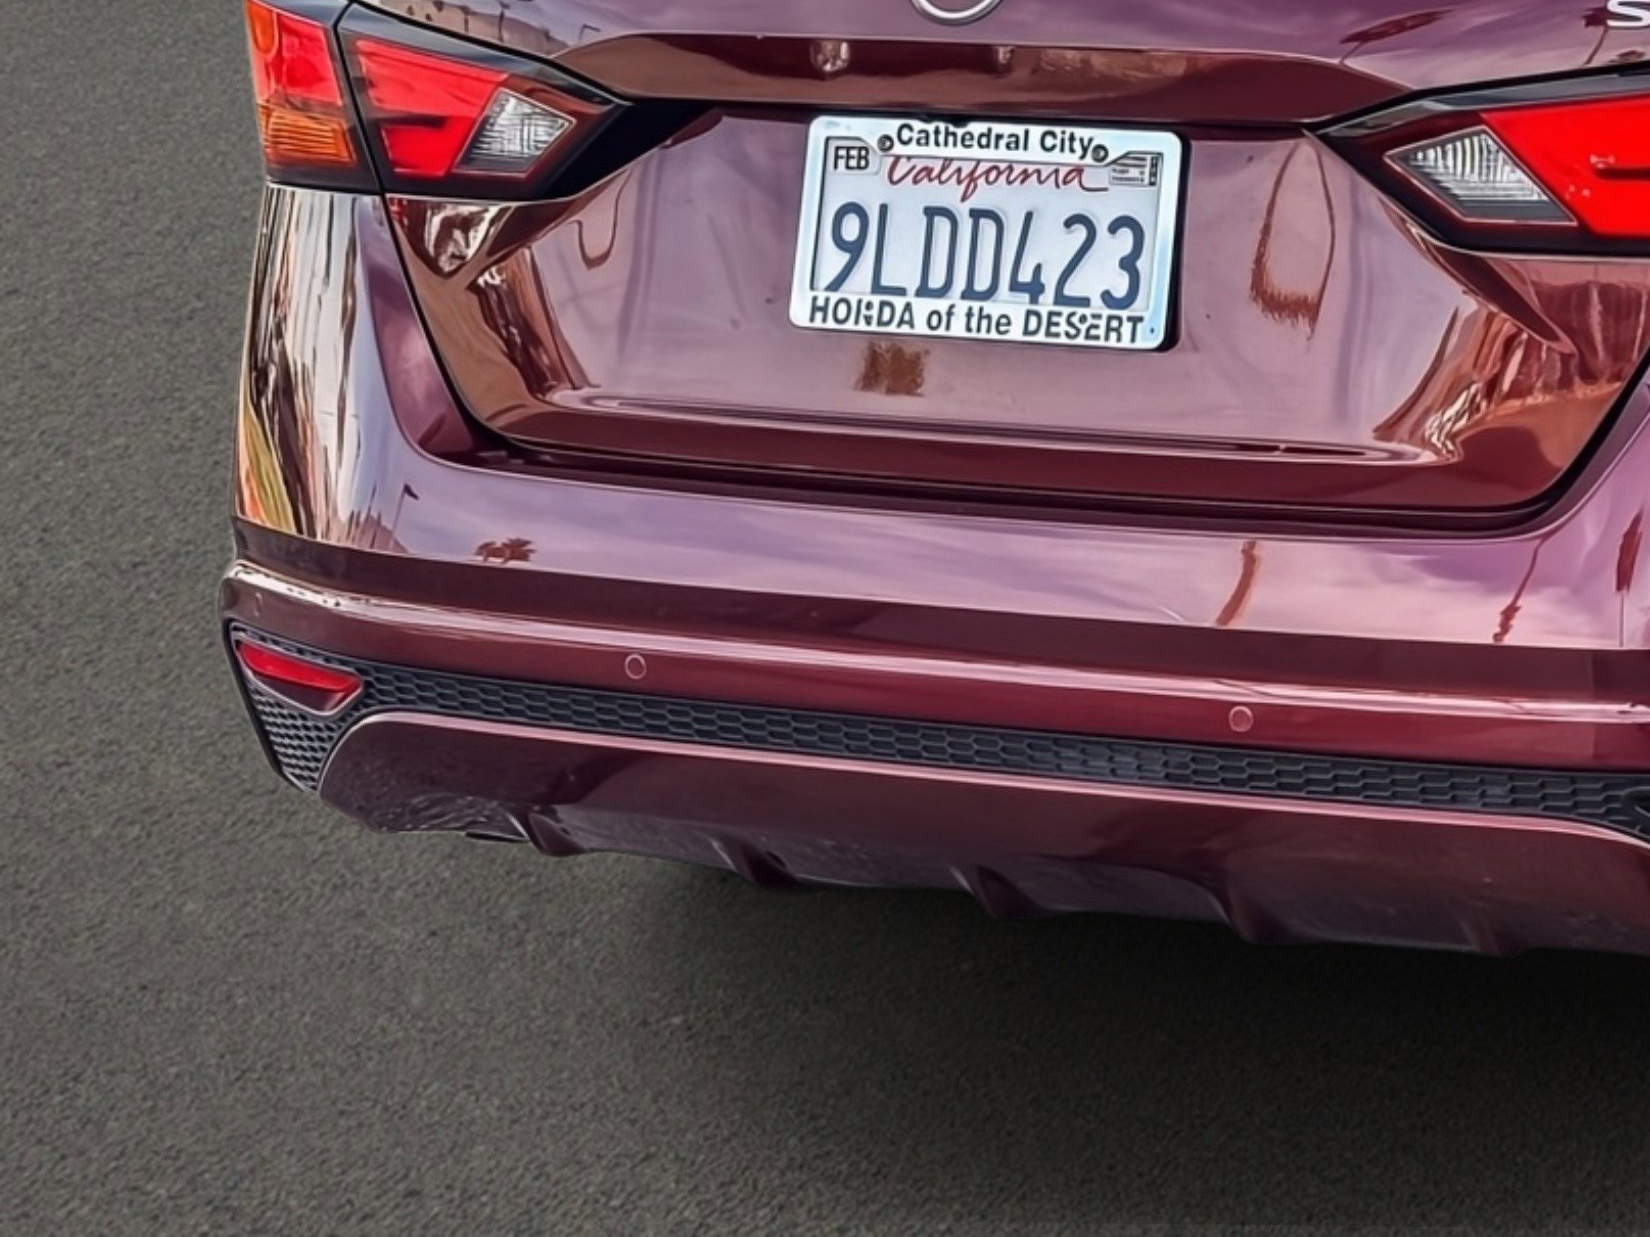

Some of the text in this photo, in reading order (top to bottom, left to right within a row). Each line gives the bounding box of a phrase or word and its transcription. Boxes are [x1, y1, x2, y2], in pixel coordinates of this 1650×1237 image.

[833, 145, 870, 171] FEB
[896, 123, 1094, 161] Cathedral City
[887, 156, 1109, 203] California
[824, 200, 1146, 311] 9LDD423
[809, 295, 1144, 344] HONDA of the DESERT
